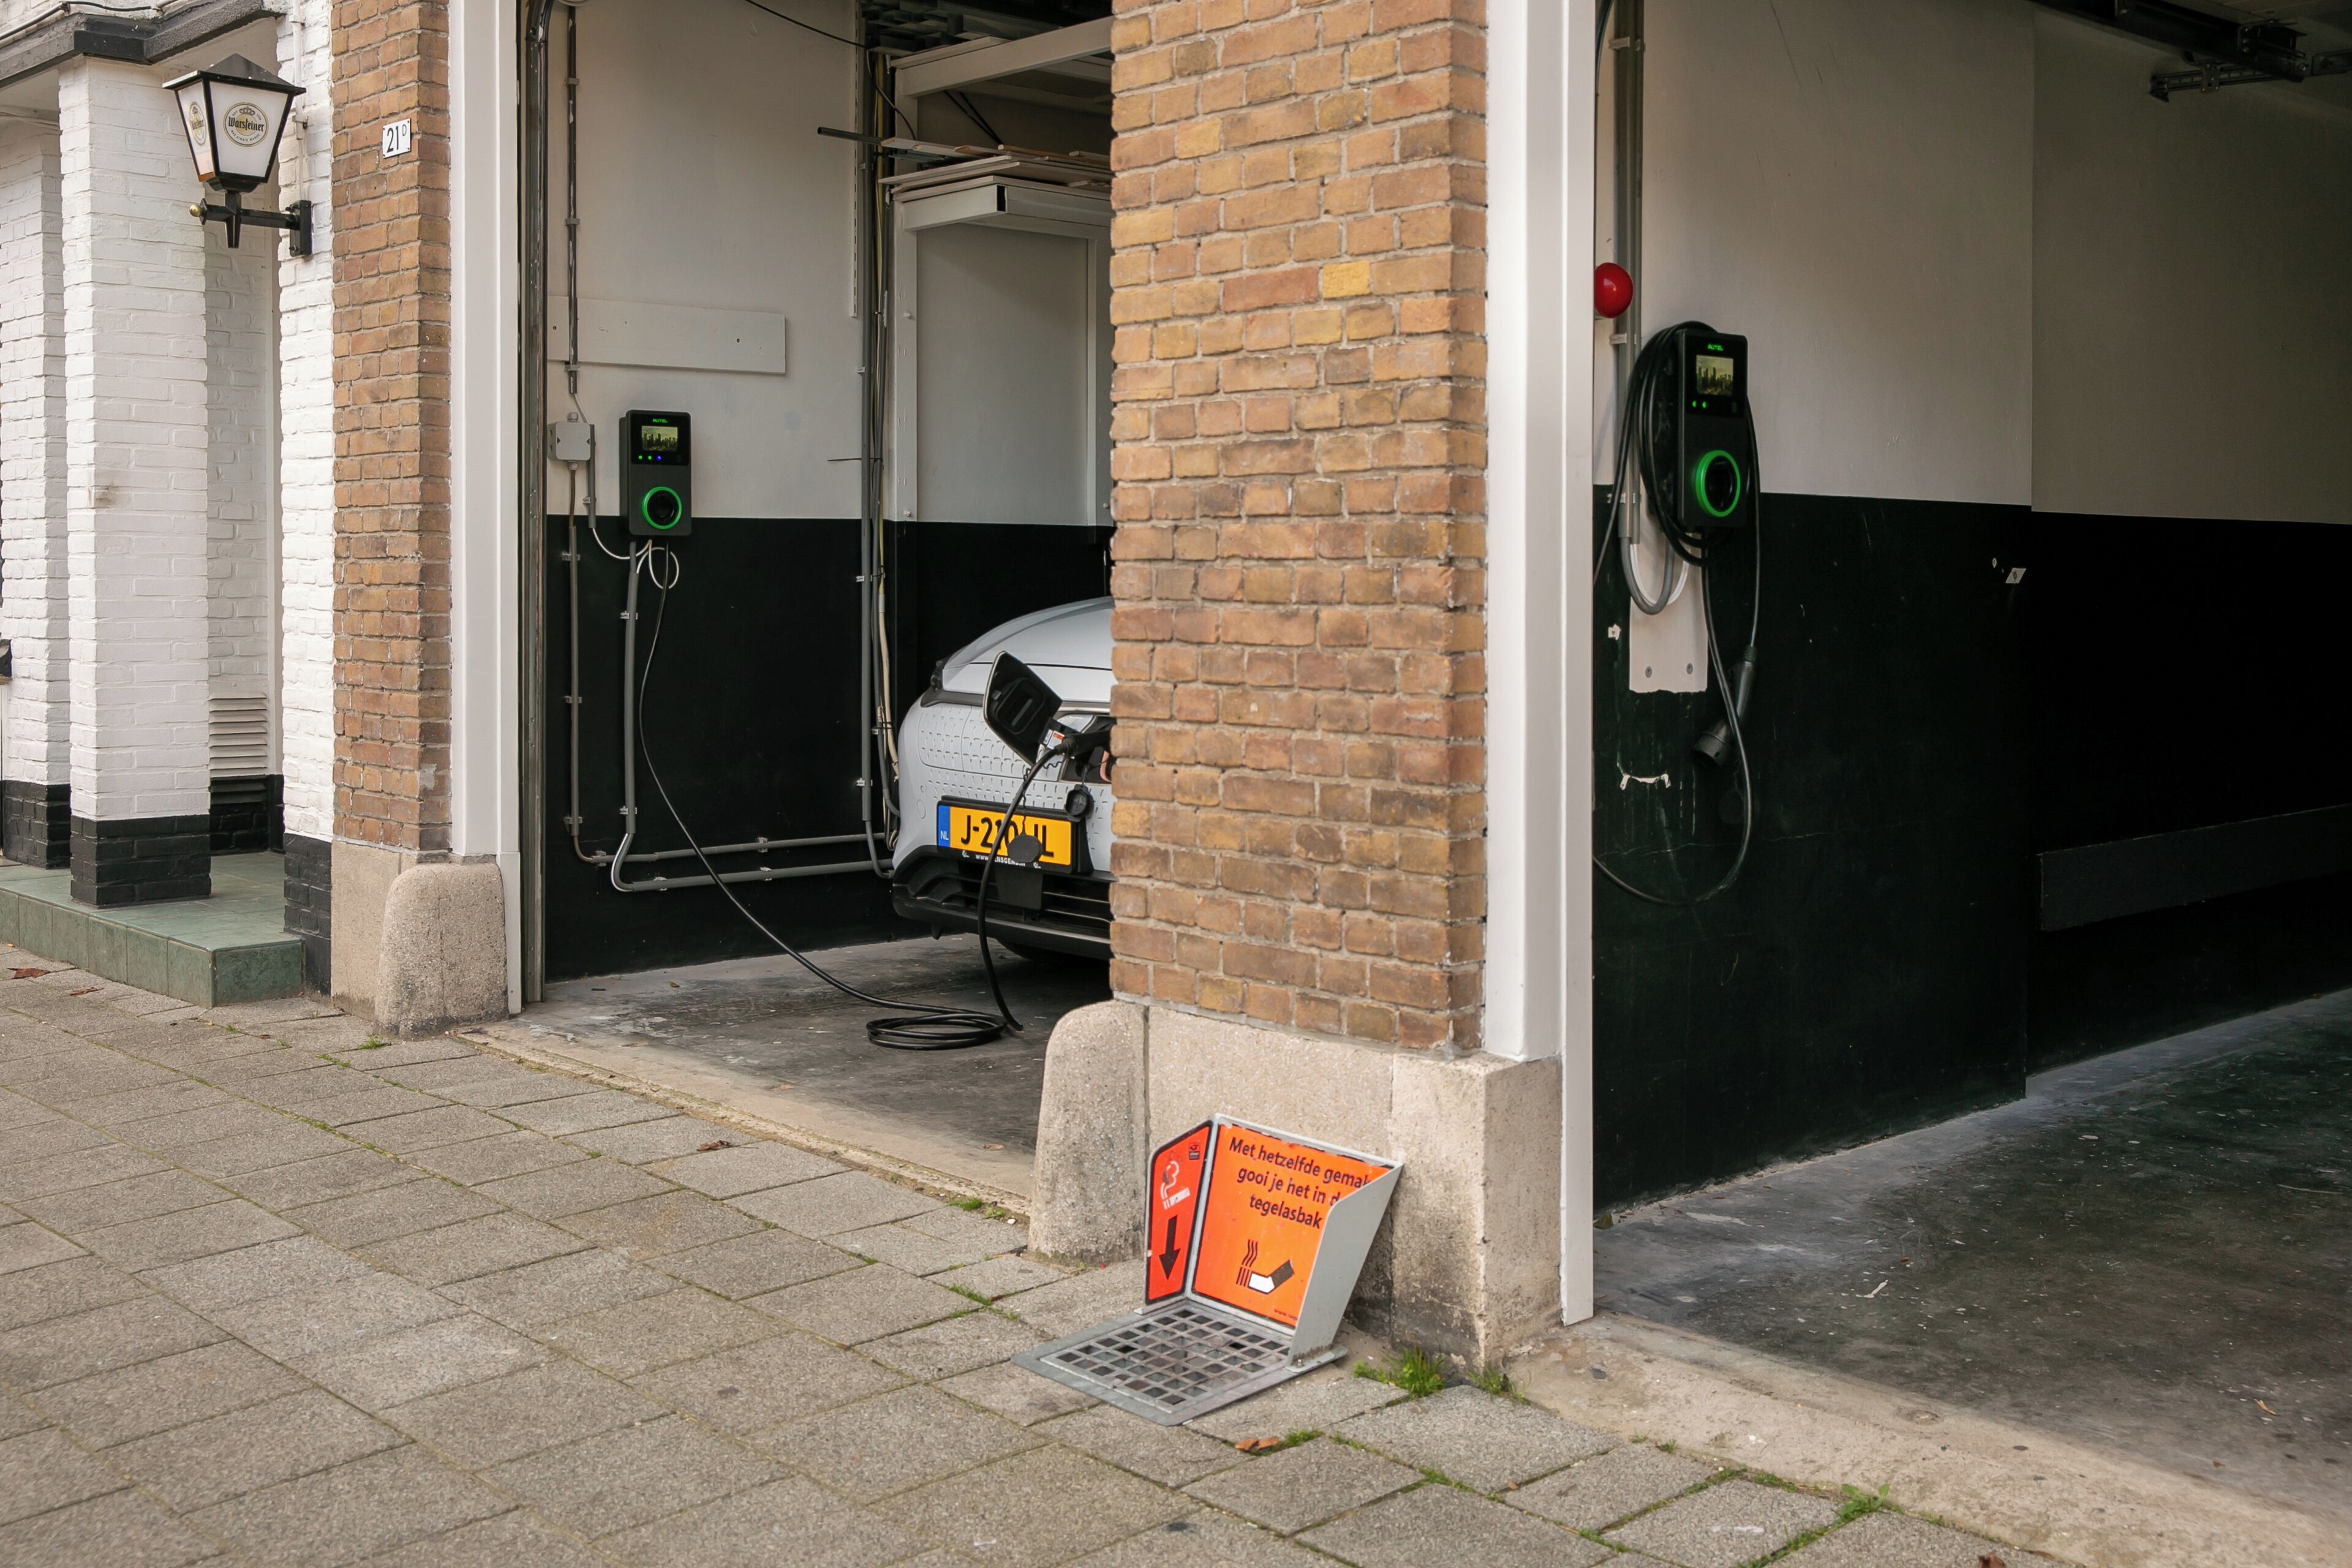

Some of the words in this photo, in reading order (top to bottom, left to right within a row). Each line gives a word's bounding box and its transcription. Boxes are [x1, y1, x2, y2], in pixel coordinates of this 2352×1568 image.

[228, 116, 265, 132] Warsteiner
[940, 830, 949, 841] NL
[1229, 1137, 1256, 1158] Met
[1257, 1145, 1321, 1177] hetzelfde
[1237, 1168, 1269, 1186] gooi
[1268, 1174, 1283, 1193] je
[1286, 1178, 1310, 1199] het
[1312, 1186, 1326, 1205] in
[1330, 1191, 1341, 1207] d
[1249, 1194, 1323, 1229] tegelasbak
